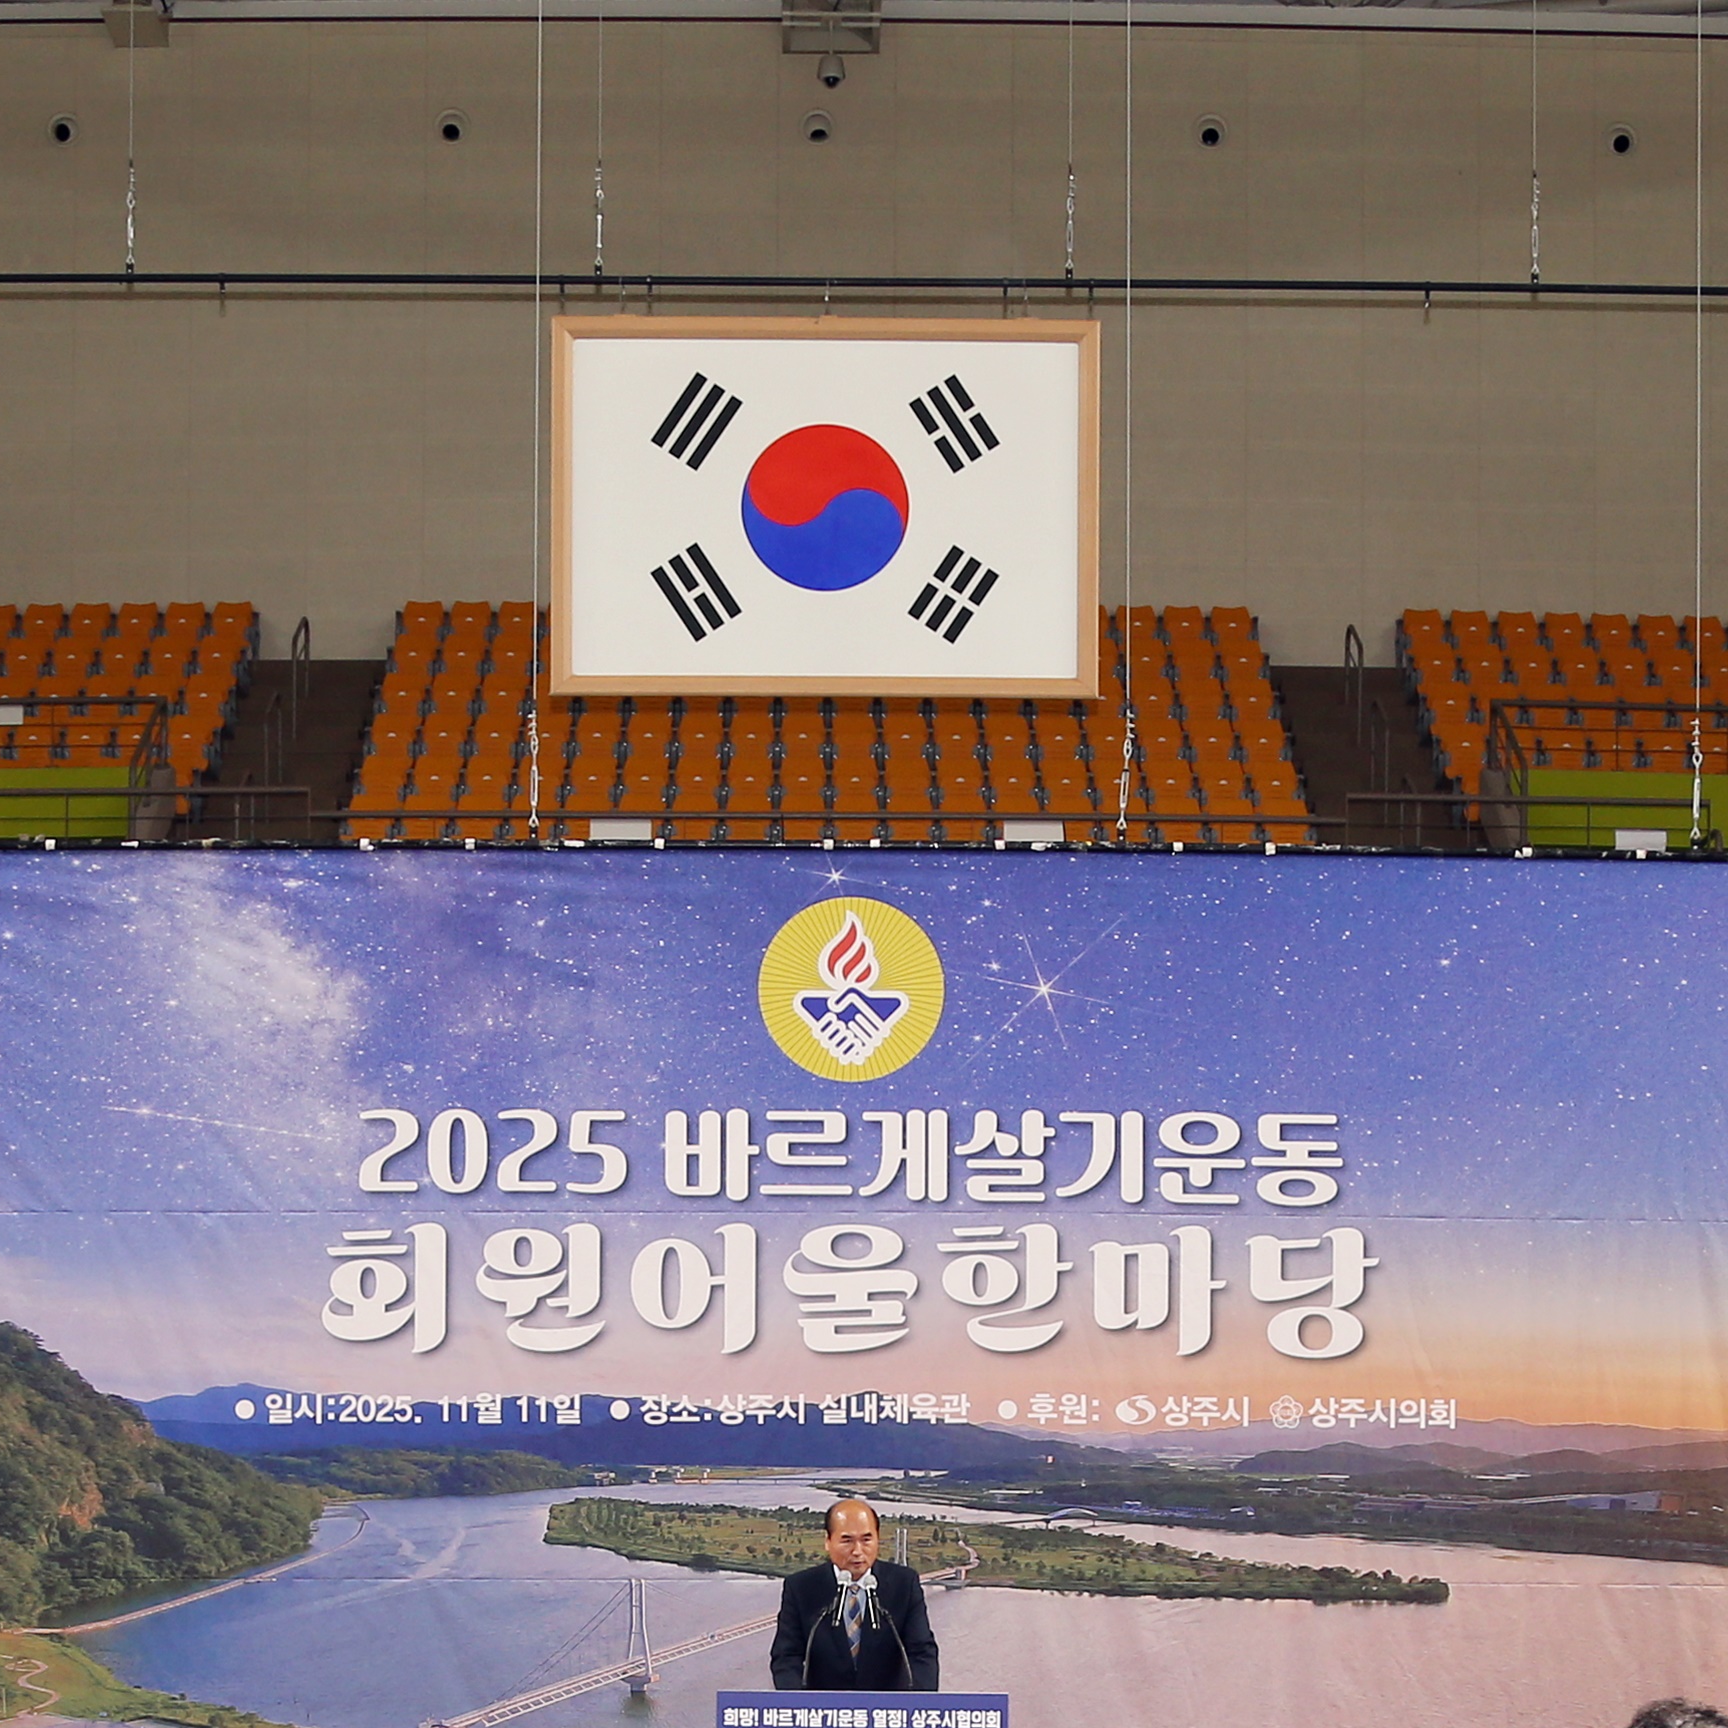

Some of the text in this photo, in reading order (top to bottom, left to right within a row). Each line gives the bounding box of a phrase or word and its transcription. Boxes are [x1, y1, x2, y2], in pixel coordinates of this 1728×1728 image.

[358, 1108, 1344, 1205] 2025 바르게살기운동
[436, 1392, 503, 1425] 11월
[515, 1391, 582, 1424] 11일
[818, 1391, 971, 1425] 실내체육관
[1027, 1393, 1100, 1426] 후원:
[1161, 1394, 1250, 1428] 상주시
[1308, 1397, 1456, 1430] 상주시의회
[723, 1708, 759, 1728] 희망!
[763, 1708, 869, 1728] 바르게살기운동
[872, 1708, 908, 1728] 열정!
